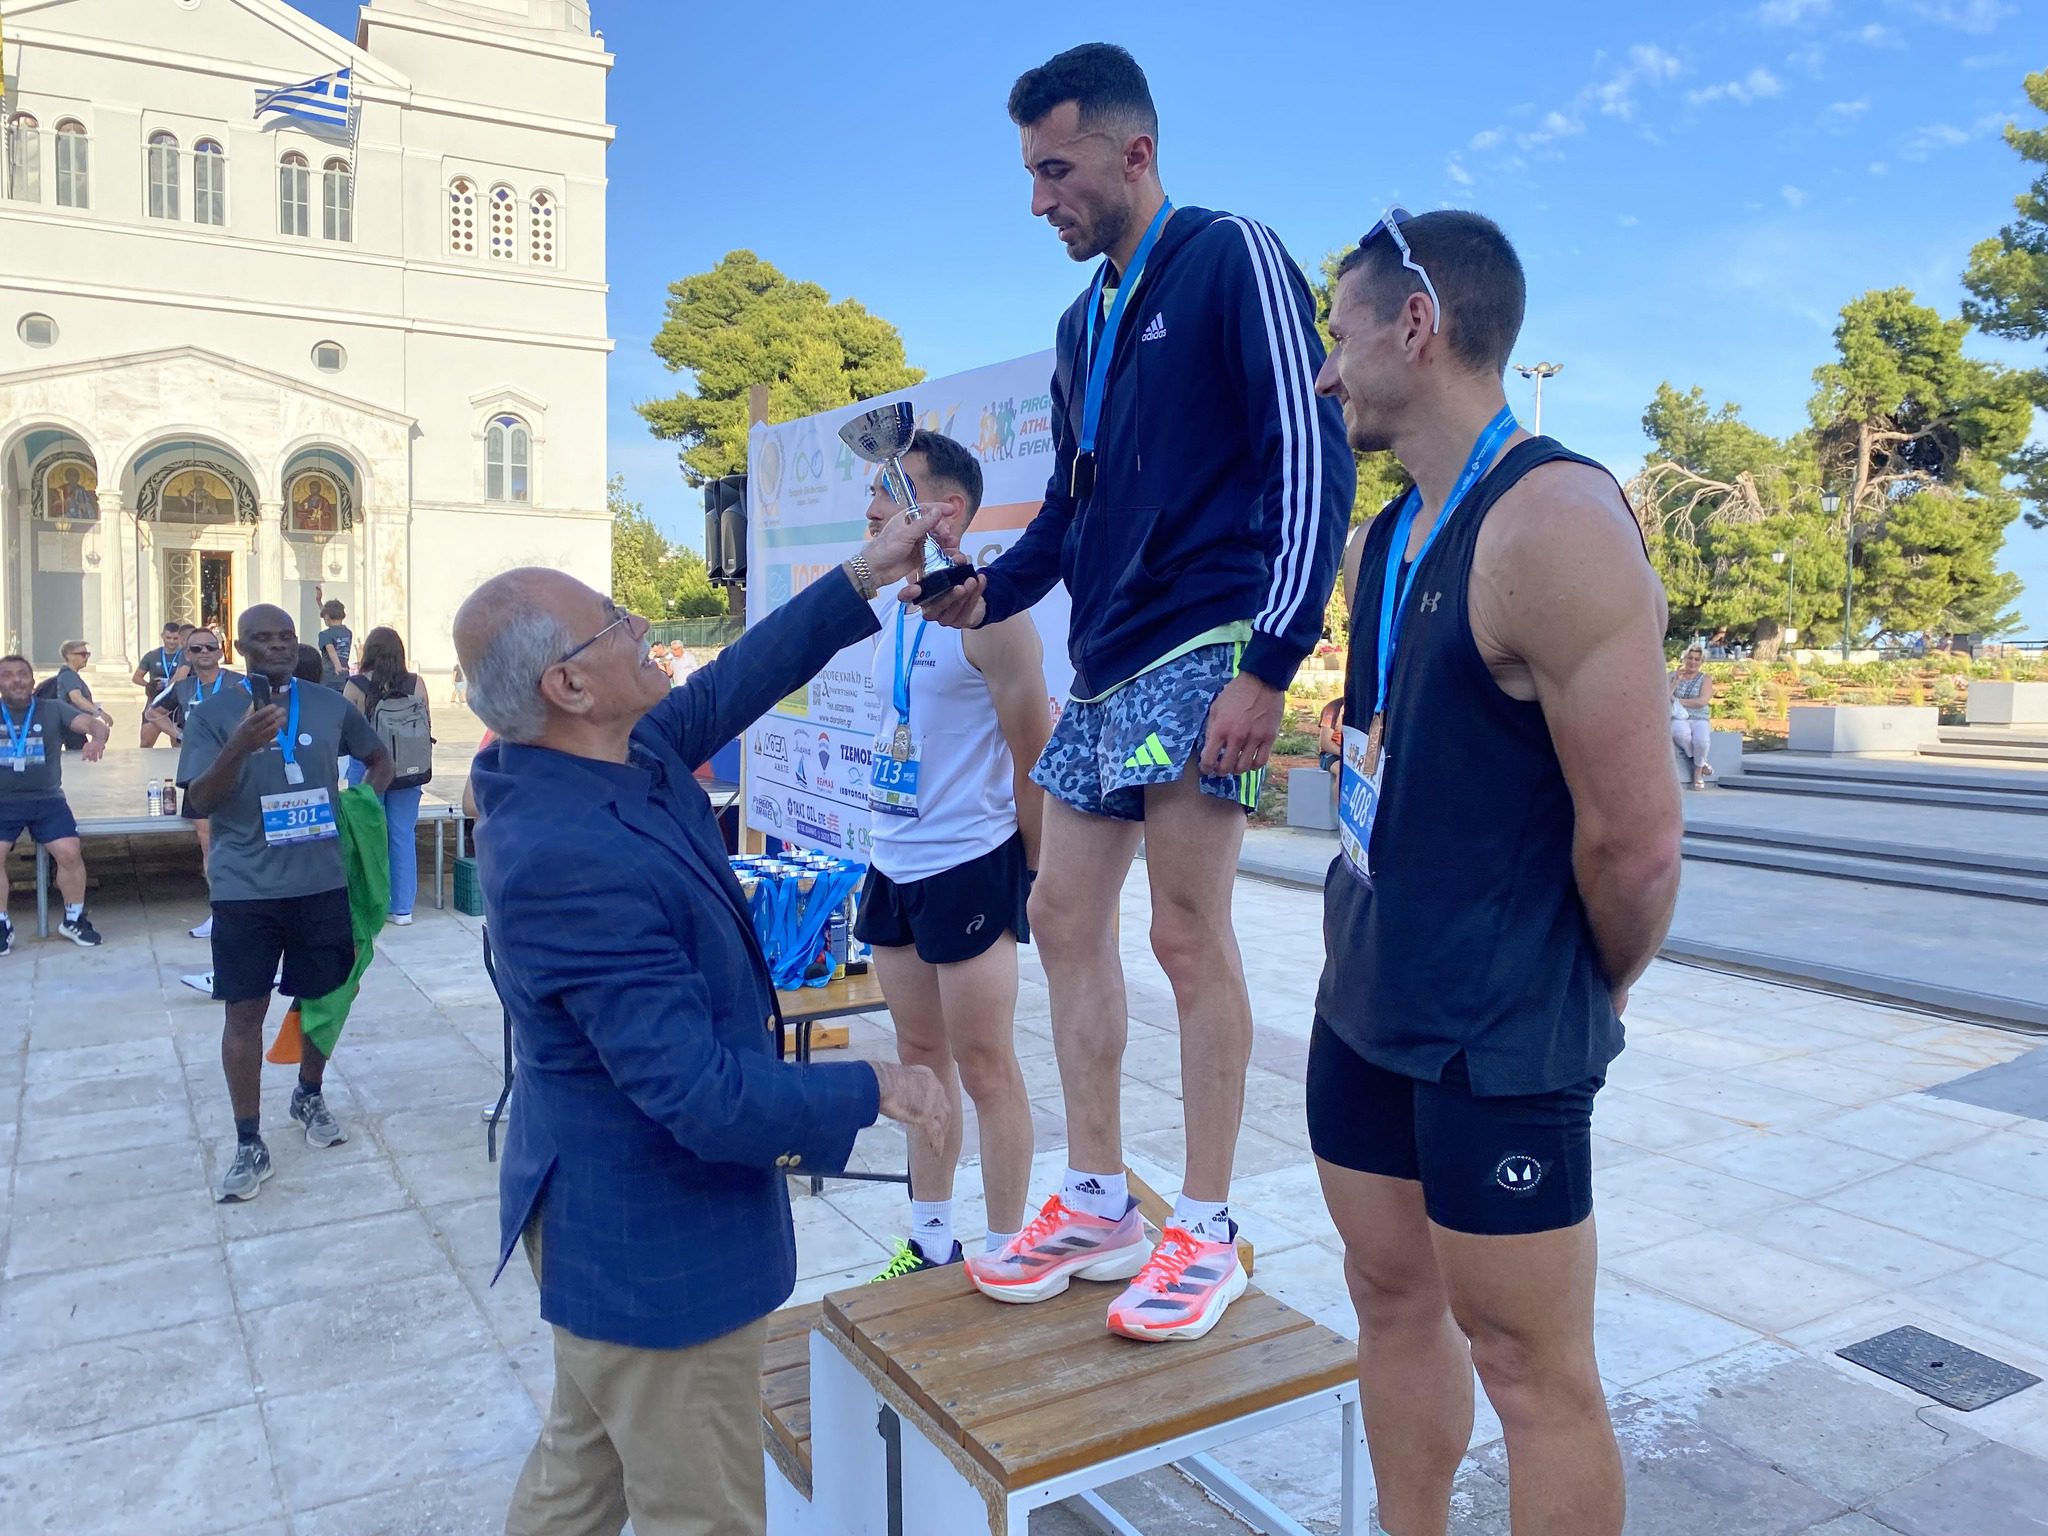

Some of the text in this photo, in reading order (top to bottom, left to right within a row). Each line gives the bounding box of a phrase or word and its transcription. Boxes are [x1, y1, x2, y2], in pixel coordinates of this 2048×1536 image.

[1141, 328, 1167, 342] adidas
[1020, 394, 1052, 415] PIRG
[1019, 416, 1052, 437] ATHL
[840, 744, 872, 766] ΤΖΕΜΟΣ
[873, 757, 903, 784] 713
[282, 799, 310, 809] RUN
[1350, 781, 1373, 829] 408
[287, 807, 318, 826] 301
[1075, 1183, 1106, 1196] adidas
